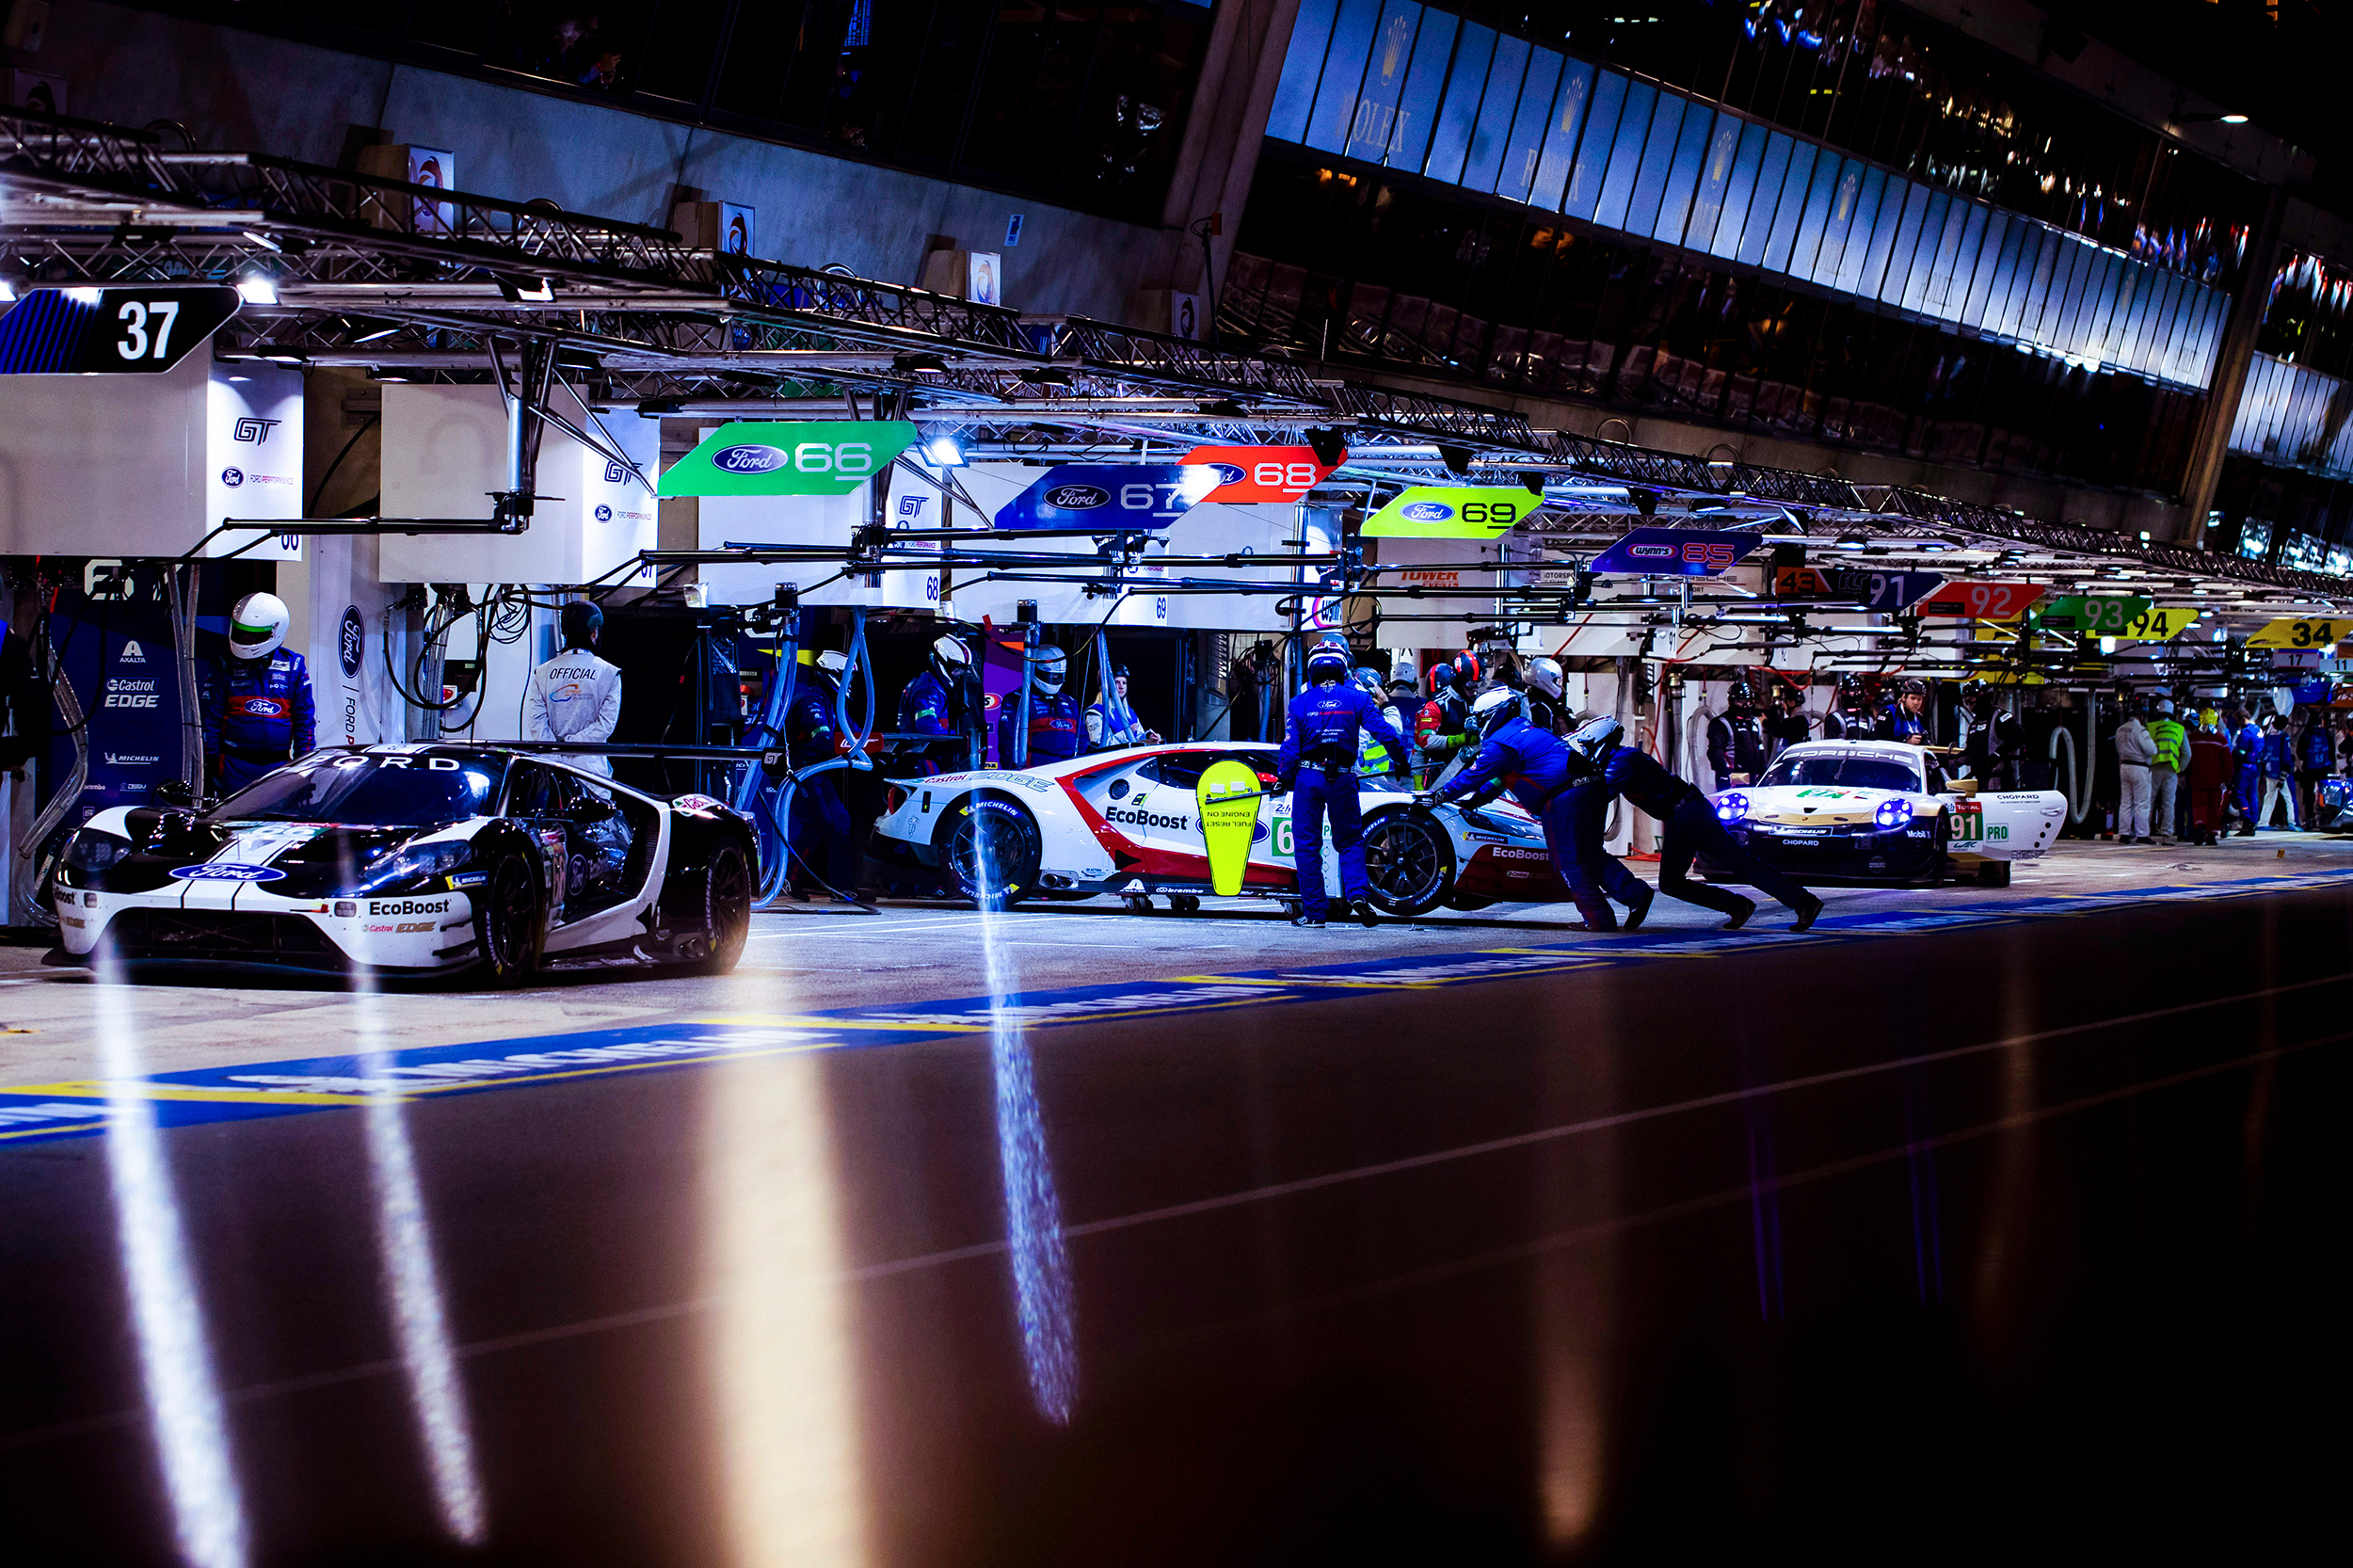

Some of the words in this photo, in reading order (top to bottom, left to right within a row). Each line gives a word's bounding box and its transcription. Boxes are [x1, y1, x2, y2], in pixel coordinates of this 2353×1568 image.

[1337, 95, 1411, 153] ROLEX
[117, 301, 180, 360] 37
[233, 417, 282, 446] GT
[726, 448, 775, 469] Ford
[795, 442, 872, 472] 66
[1254, 462, 1317, 486] 68
[900, 495, 930, 519] GT
[1056, 488, 1100, 506] Ford
[1120, 483, 1179, 510] 67
[1411, 504, 1445, 520] Ford
[1462, 503, 1516, 523] 69
[1682, 543, 1734, 565] 85
[926, 576, 939, 600] 68
[1781, 571, 1816, 593] 43
[1869, 573, 1904, 605] 91
[1156, 597, 1167, 619] 69
[1971, 585, 2012, 616] 92
[2084, 600, 2123, 628] 93
[2132, 611, 2169, 637] 94
[344, 618, 362, 664] Ford
[2291, 622, 2334, 647] 34
[2289, 654, 2303, 666] 17
[2335, 659, 2347, 670] 11
[550, 667, 597, 680] OFFICIAL
[119, 679, 154, 692] Castrol
[104, 695, 160, 708] EDGE
[249, 700, 276, 713] Ford
[345, 696, 356, 733] FORD
[299, 755, 461, 771] FORD
[763, 752, 783, 765] GT
[1783, 750, 1913, 764] PORSCHE
[924, 774, 968, 783] Castrol
[969, 772, 1055, 793] EDGE
[975, 801, 1018, 816] MICHELIN
[1106, 806, 1188, 830] EcoBoost
[1276, 820, 1295, 855] 6
[1907, 830, 1926, 839] Mobil
[1949, 814, 1977, 840] 91
[1987, 826, 2008, 840] PRO
[1492, 846, 1550, 861] EcoBoost
[189, 864, 264, 880] Ford
[370, 899, 450, 915] EcoBoost
[395, 921, 437, 933] EDGE
